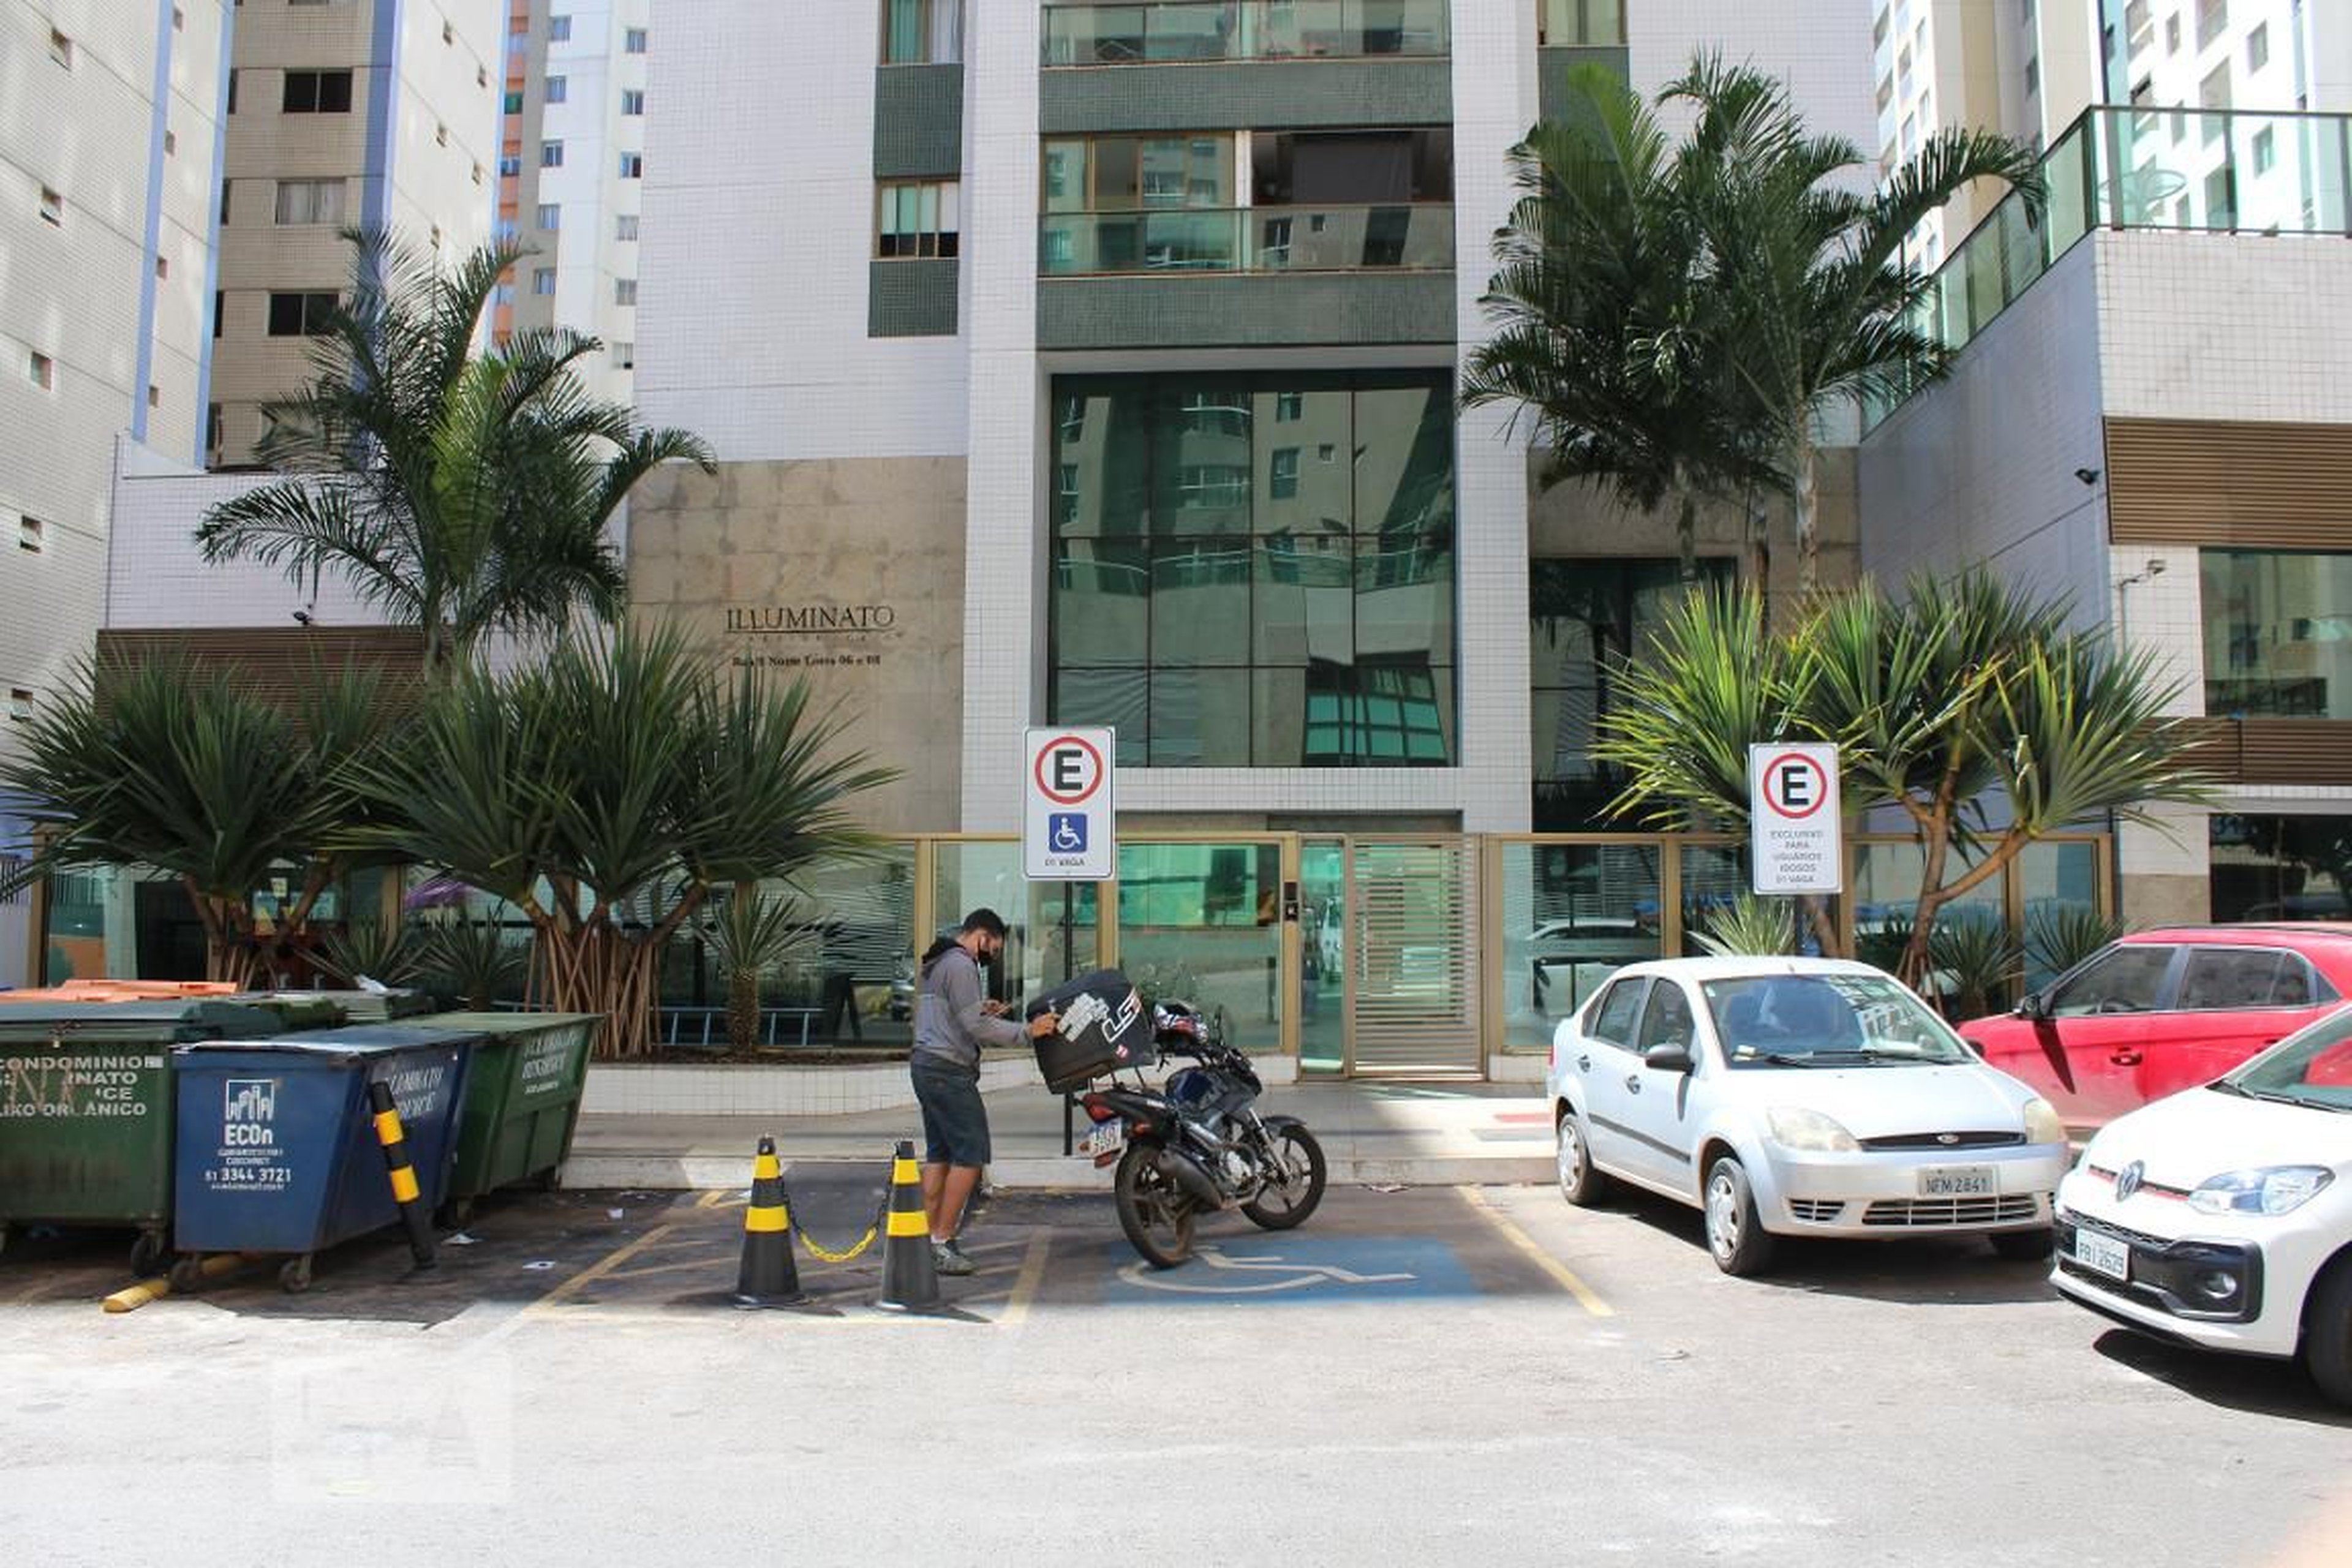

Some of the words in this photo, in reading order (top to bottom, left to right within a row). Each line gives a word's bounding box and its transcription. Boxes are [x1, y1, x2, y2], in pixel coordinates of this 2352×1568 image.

[726, 605, 895, 630] ILLUMINATO
[1054, 749, 1083, 791] E
[1781, 766, 1809, 805] E
[1779, 863, 1817, 872] IDOSOS
[1789, 874, 1814, 883] VAGA
[221, 1167, 255, 1182] 3344
[258, 1167, 292, 1183] 3721
